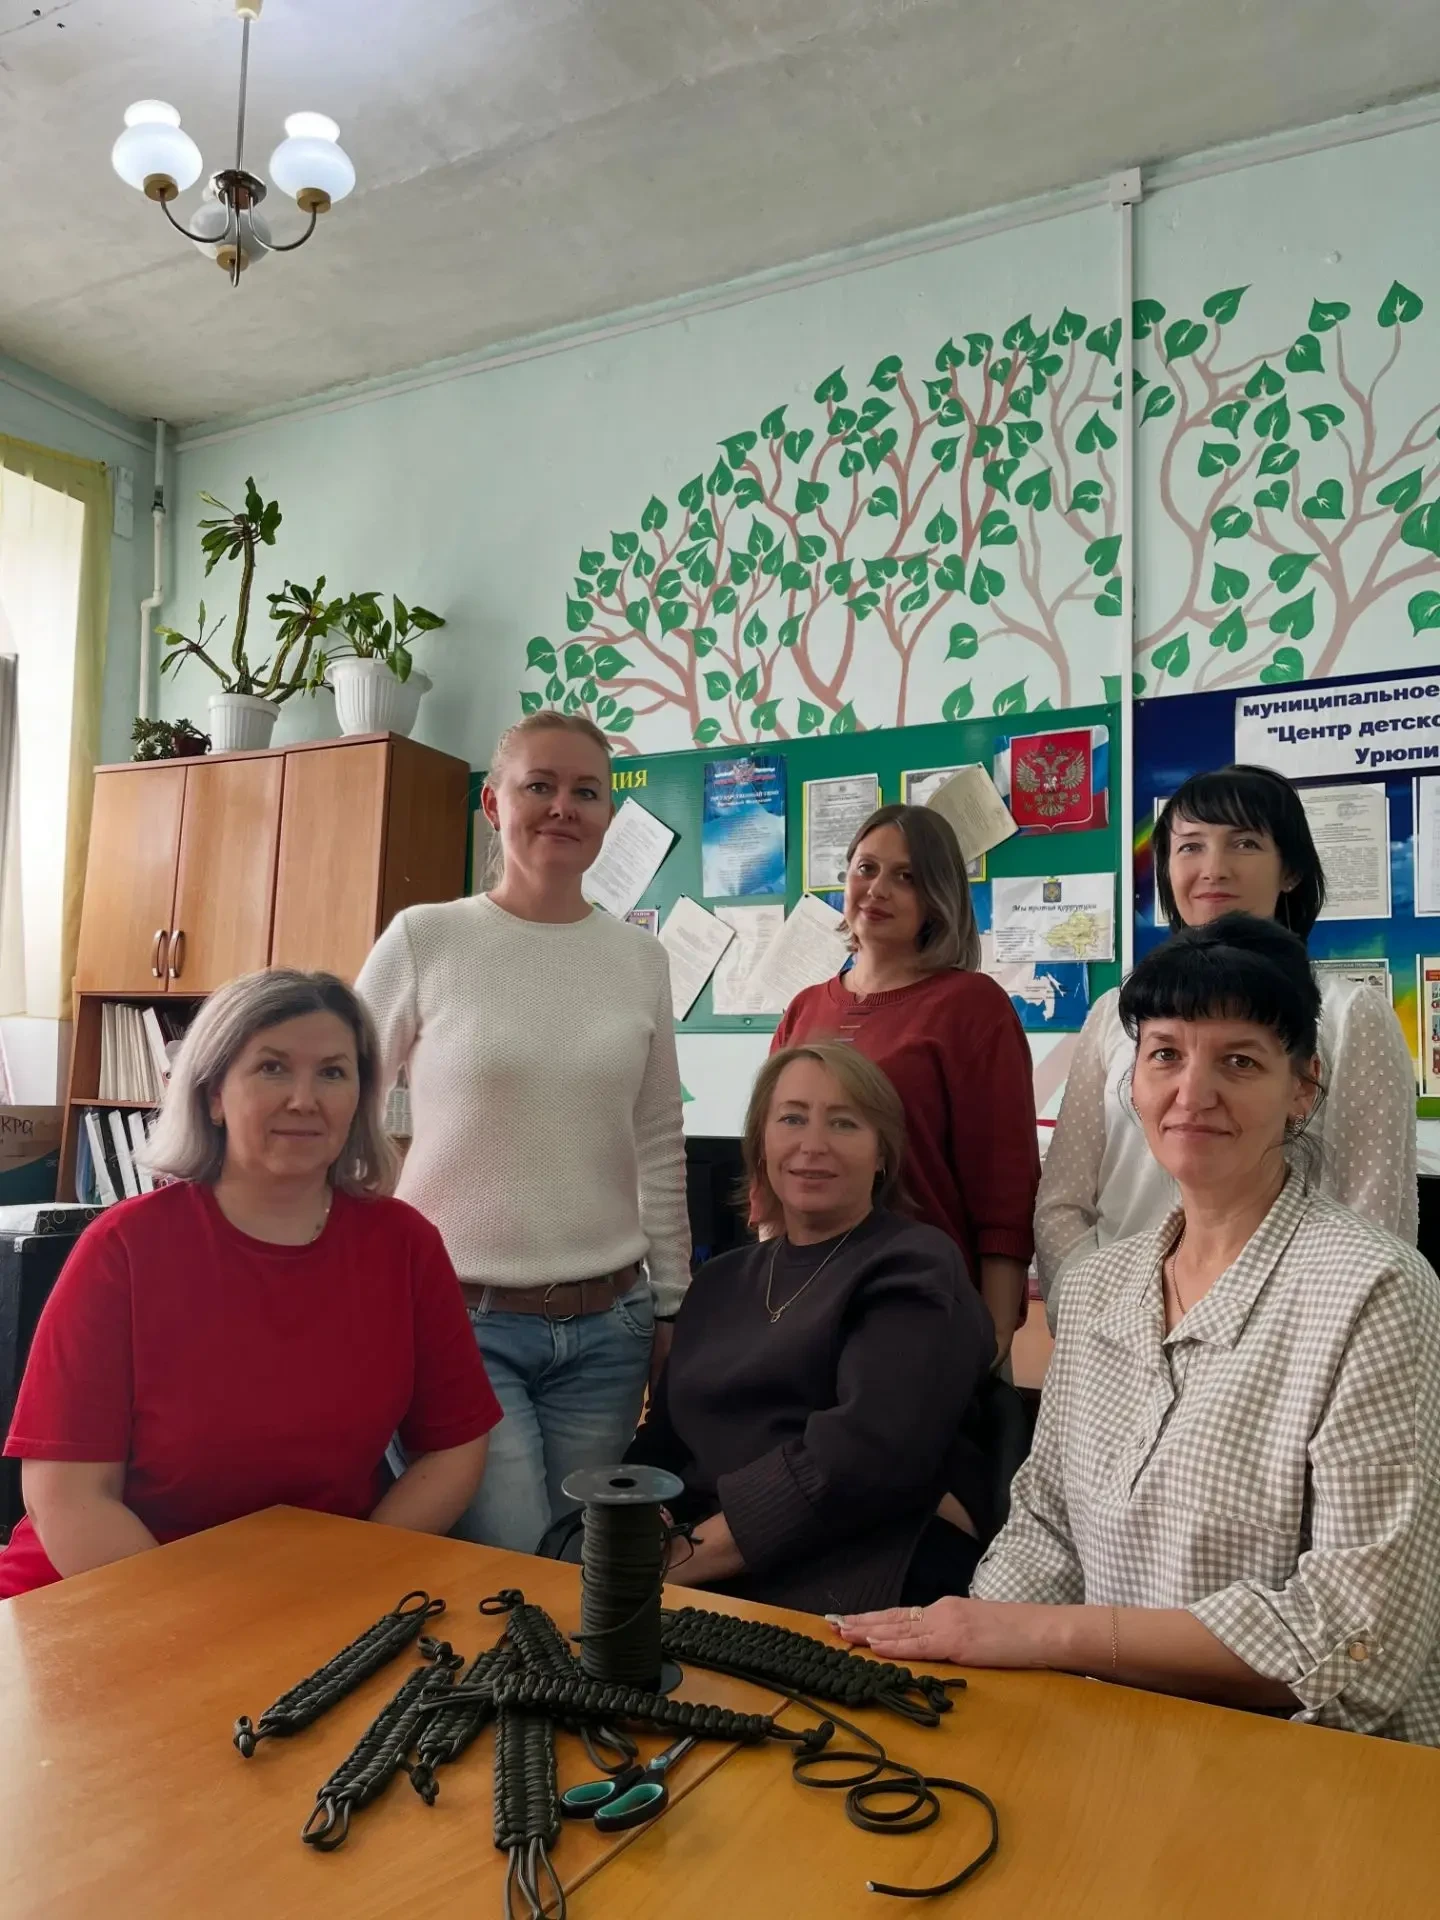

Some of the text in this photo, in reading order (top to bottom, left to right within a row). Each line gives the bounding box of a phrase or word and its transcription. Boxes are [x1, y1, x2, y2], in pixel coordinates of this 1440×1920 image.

[1243, 684, 1440, 719] муниципальное
[1267, 722, 1352, 744] "Центр
[1355, 745, 1439, 767] Урюпи
